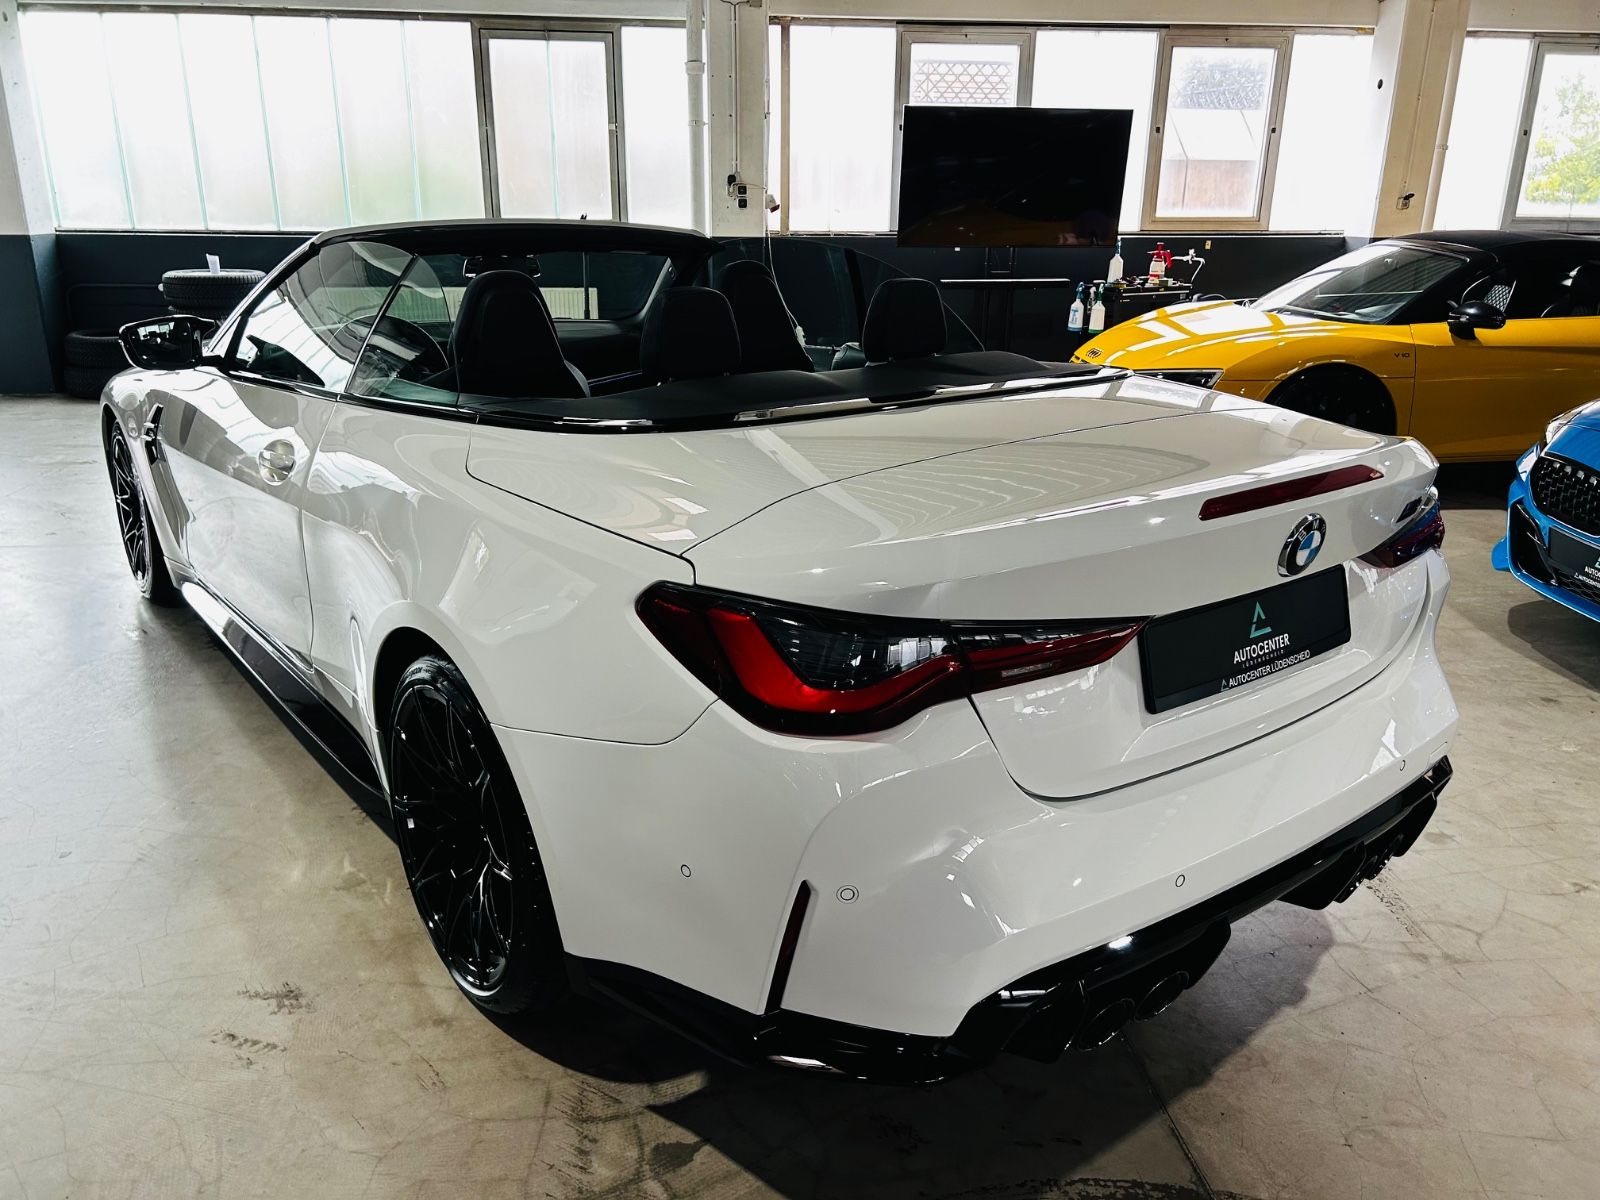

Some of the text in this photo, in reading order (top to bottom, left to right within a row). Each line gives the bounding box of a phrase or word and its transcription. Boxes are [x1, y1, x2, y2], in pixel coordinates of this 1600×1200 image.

[1233, 633, 1290, 664] AUTOCENTER
[1228, 649, 1311, 688] AUTOCENTER LÜDENSCHEID
